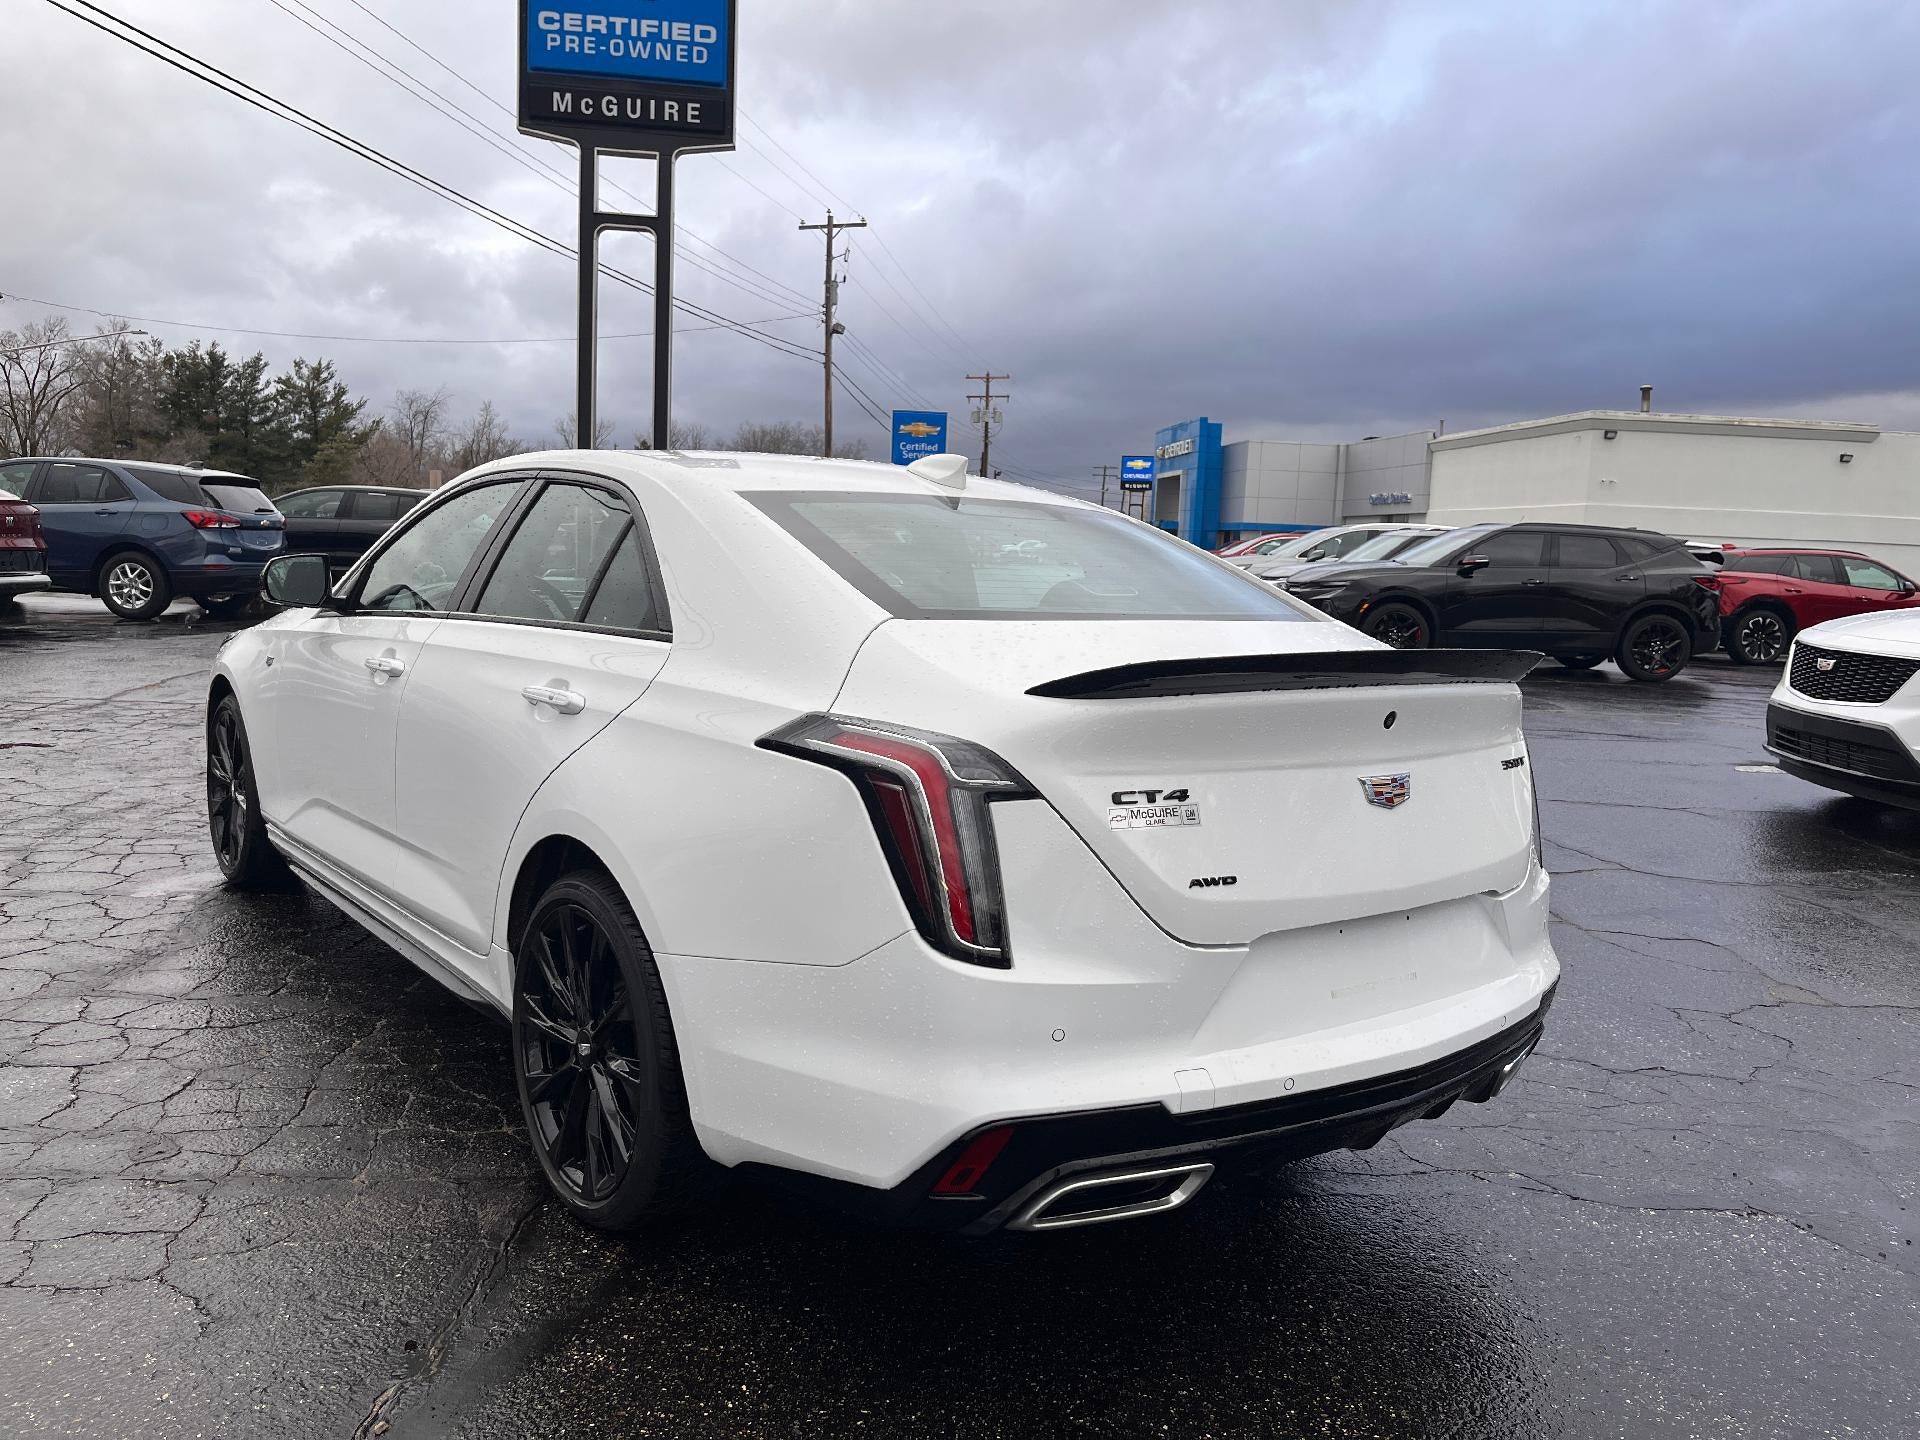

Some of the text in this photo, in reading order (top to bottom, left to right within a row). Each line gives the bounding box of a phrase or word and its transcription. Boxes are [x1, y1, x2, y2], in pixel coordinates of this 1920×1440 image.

[538, 11, 717, 44] CERTIFIED
[546, 34, 709, 64] PRE-OWNED
[552, 91, 701, 124] McGUIRE
[900, 442, 938, 451] Certified
[1111, 788, 1190, 805] CT4
[1130, 807, 1179, 819] McGUIRE
[1185, 809, 1196, 818] GM
[1189, 876, 1237, 889] AWD
